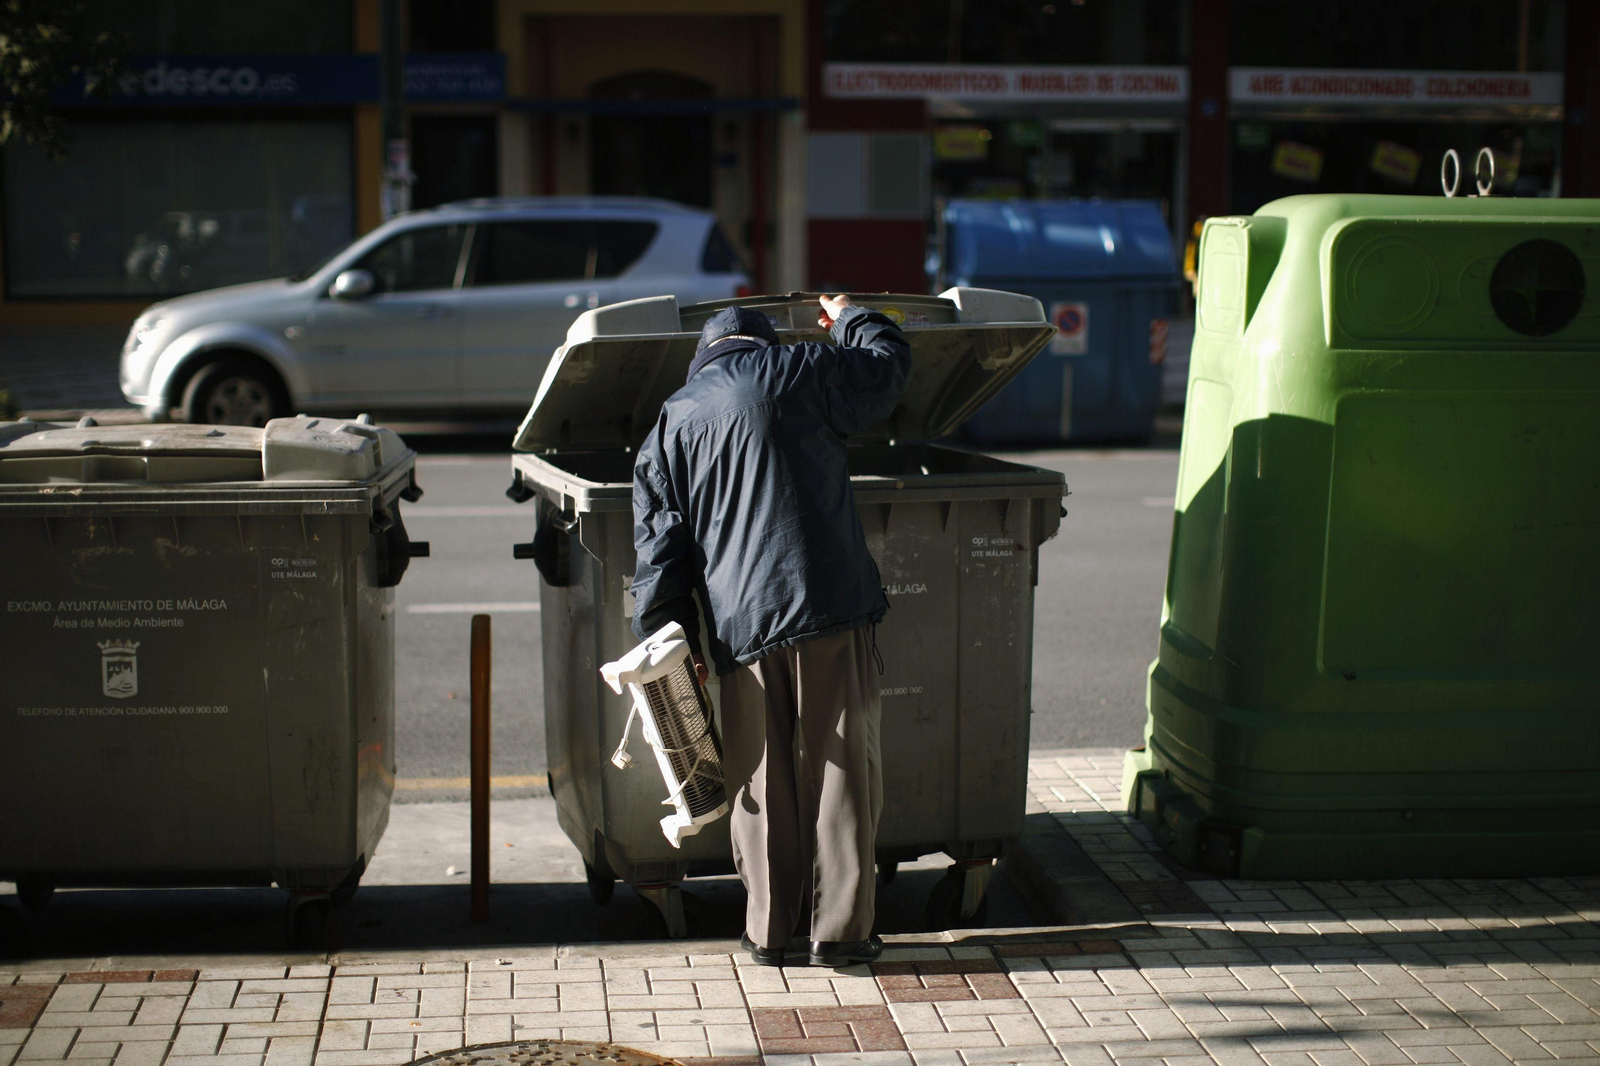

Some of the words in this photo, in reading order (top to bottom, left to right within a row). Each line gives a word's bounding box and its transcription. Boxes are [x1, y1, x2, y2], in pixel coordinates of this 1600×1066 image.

[1290, 75, 1414, 97] ACONDICIONADO
[985, 549, 1013, 557] MÁLAGA
[271, 571, 285, 579] UTE
[286, 570, 317, 579] MÁLAGA
[7, 601, 54, 612] EXCMO.
[57, 599, 153, 612] AYUNTAMIENTO
[156, 599, 174, 611] DE
[176, 597, 228, 611] MÁLAGA
[53, 616, 78, 628] Área
[80, 617, 95, 628] de
[97, 617, 131, 628] Medio
[133, 616, 184, 628] Ambiente
[16, 706, 62, 716] TELÉFONO
[64, 707, 77, 716] DE
[78, 705, 124, 716] ATENCIÓN
[125, 706, 178, 716] CIUDADANA
[178, 705, 229, 715] 900.900.000
